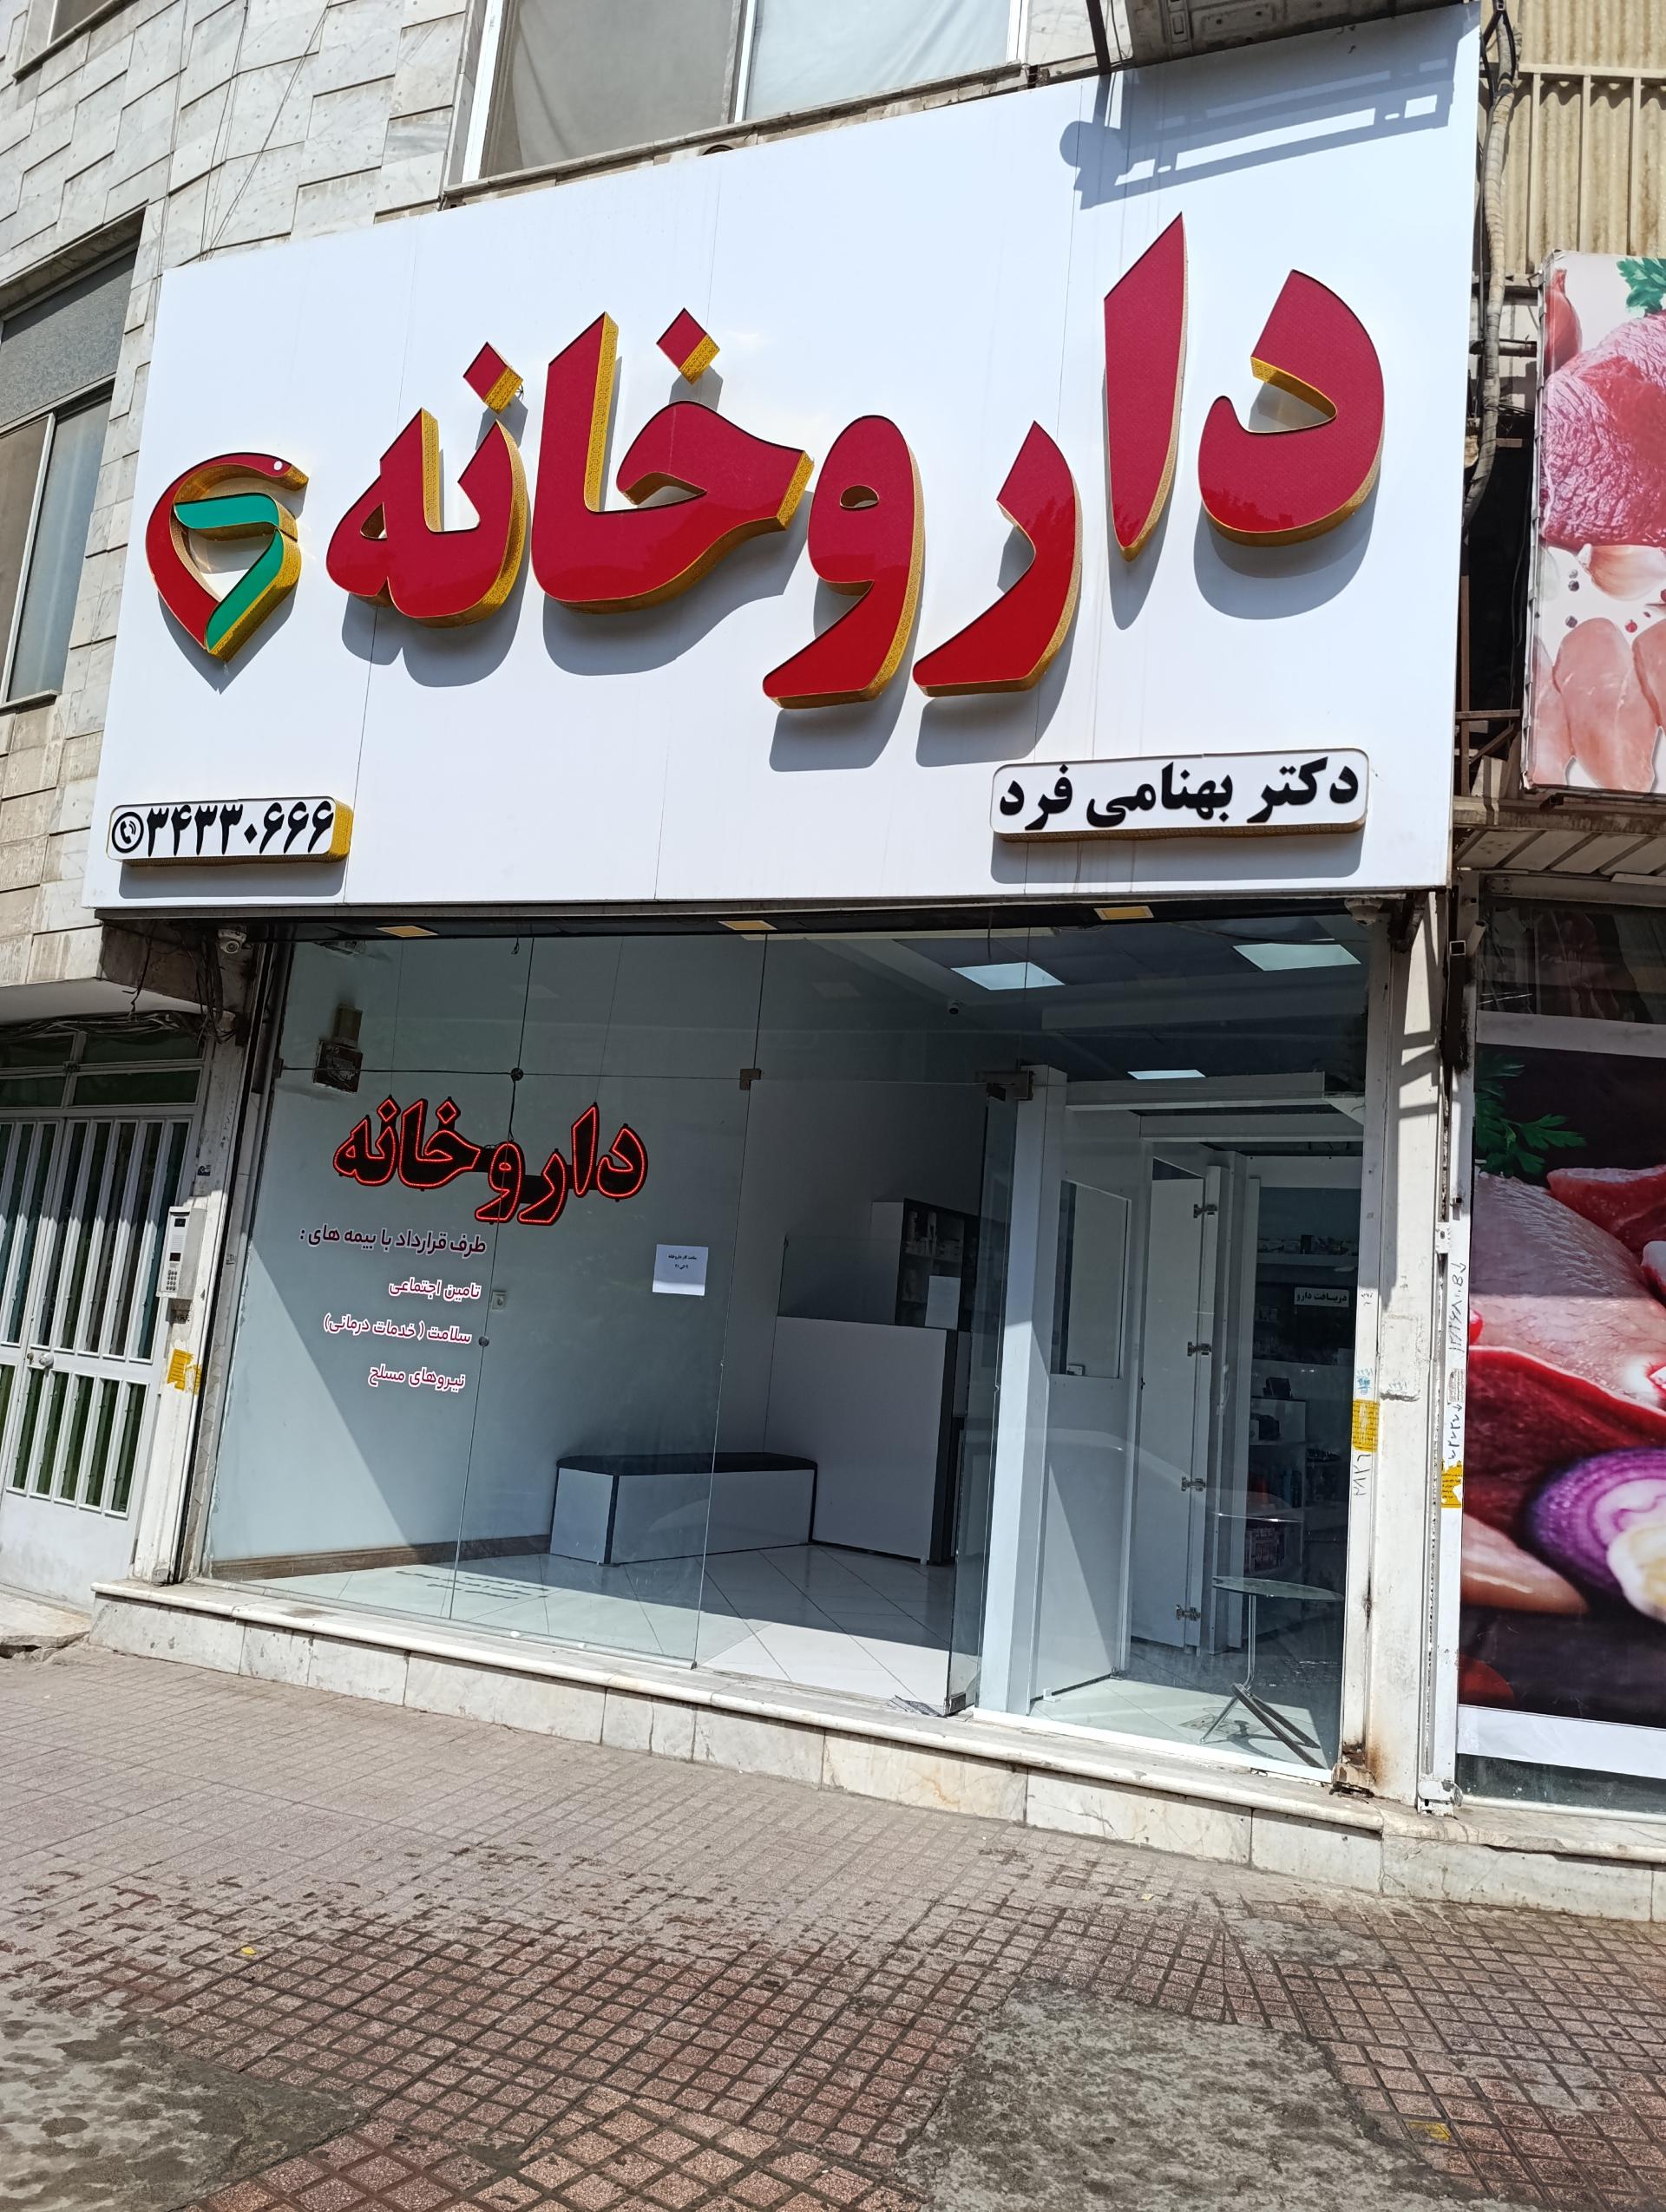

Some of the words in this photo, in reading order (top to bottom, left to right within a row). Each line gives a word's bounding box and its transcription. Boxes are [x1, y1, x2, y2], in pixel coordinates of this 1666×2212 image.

[326, 212, 1387, 711] داروخانه
[998, 762, 1073, 831] فرد
[1086, 762, 1234, 828] بهنامی
[1247, 756, 1360, 824] دکتر
[146, 801, 334, 857] ۳۴۳۳۰۶۶۶
[331, 1093, 649, 1227] داروخانه
[306, 1223, 341, 1247] های
[343, 1228, 377, 1250] بیمه
[380, 1227, 393, 1252] با
[395, 1229, 449, 1255] قرارداد
[449, 1234, 487, 1258] طرف
[388, 1277, 442, 1299] اجتماعی
[443, 1283, 482, 1303] تامین
[372, 1319, 416, 1338] خدمات
[427, 1325, 473, 1344] سلامت
[367, 1363, 406, 1387] مسلح
[409, 1366, 467, 1393] نیروهای
